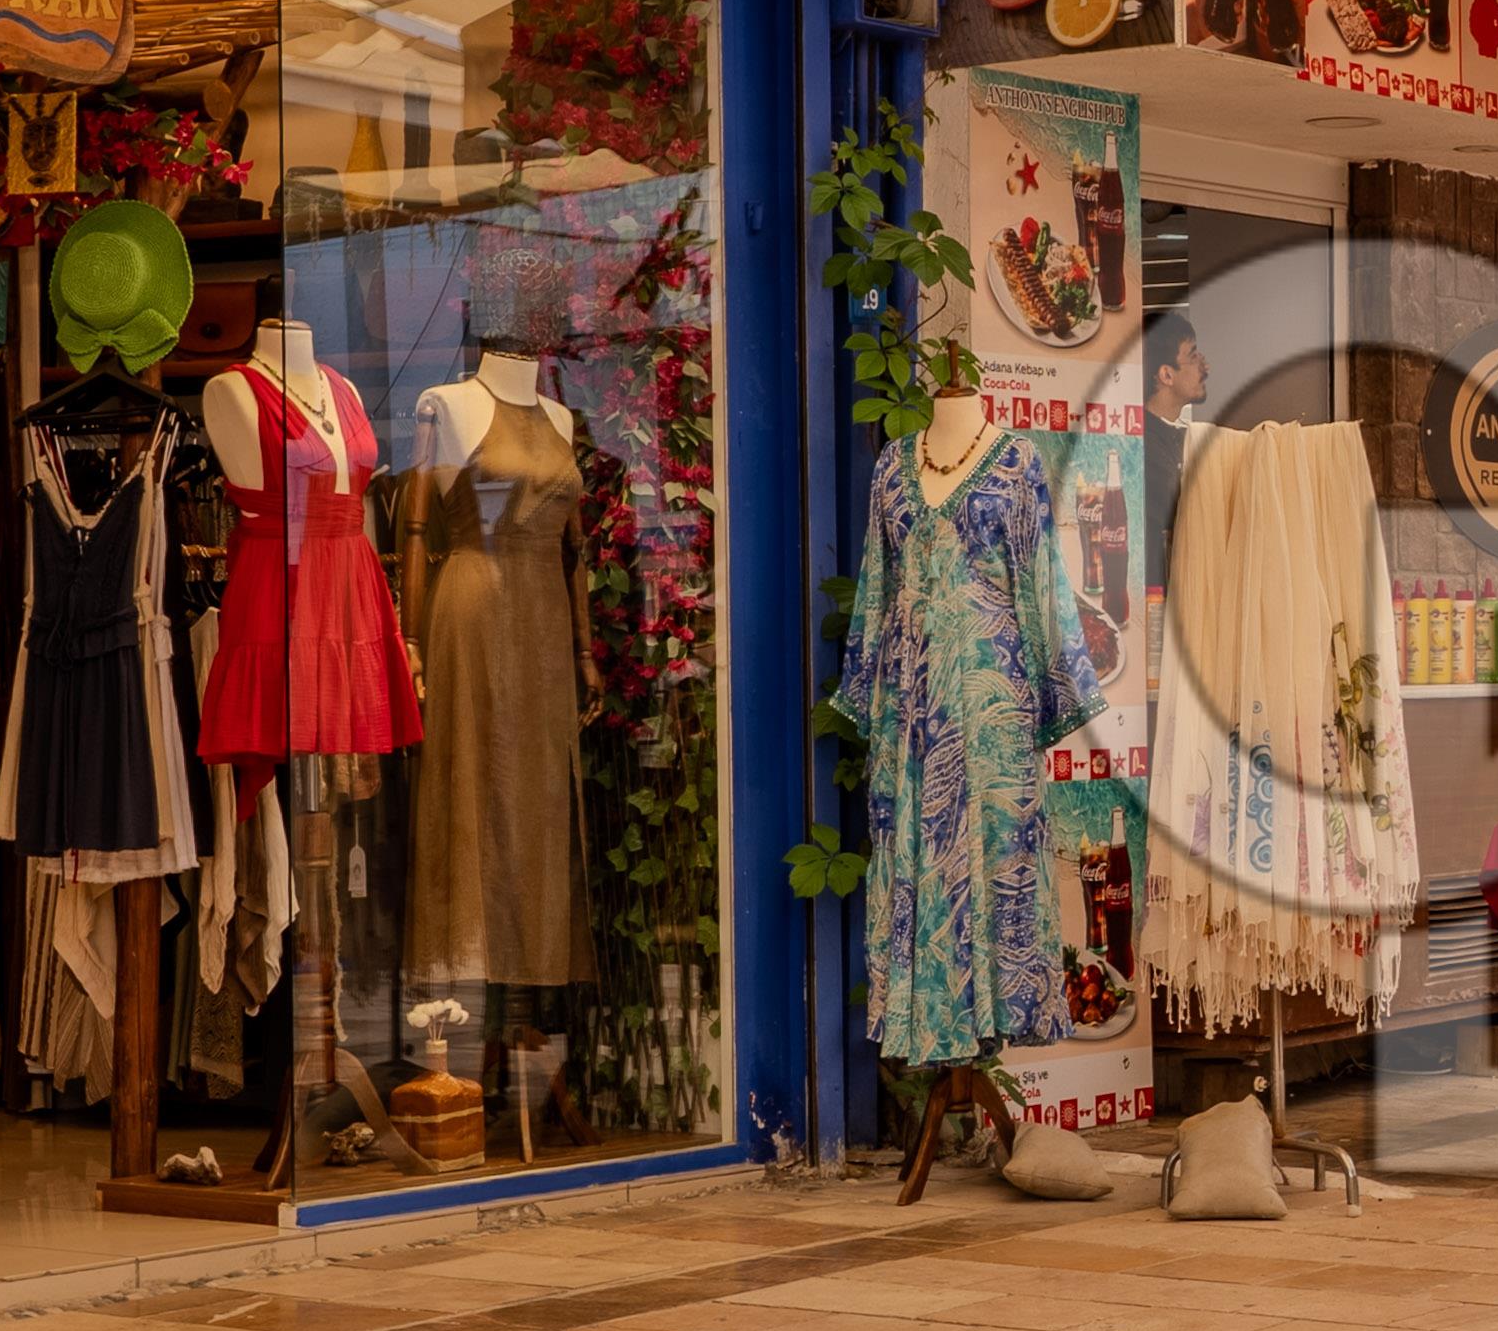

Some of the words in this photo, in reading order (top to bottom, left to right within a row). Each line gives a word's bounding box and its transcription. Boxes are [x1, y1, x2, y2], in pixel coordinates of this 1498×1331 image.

[986, 84, 1053, 114] ANTHONY'S
[1053, 94, 1105, 122] ENGLISH
[1105, 104, 1126, 125] PUB
[862, 289, 878, 310] 19
[983, 360, 1013, 374] Adana
[1014, 363, 1044, 377] Kebap
[1046, 367, 1057, 377] ve
[983, 377, 1031, 391] Coca-Cola
[1038, 1070, 1049, 1081] ve
